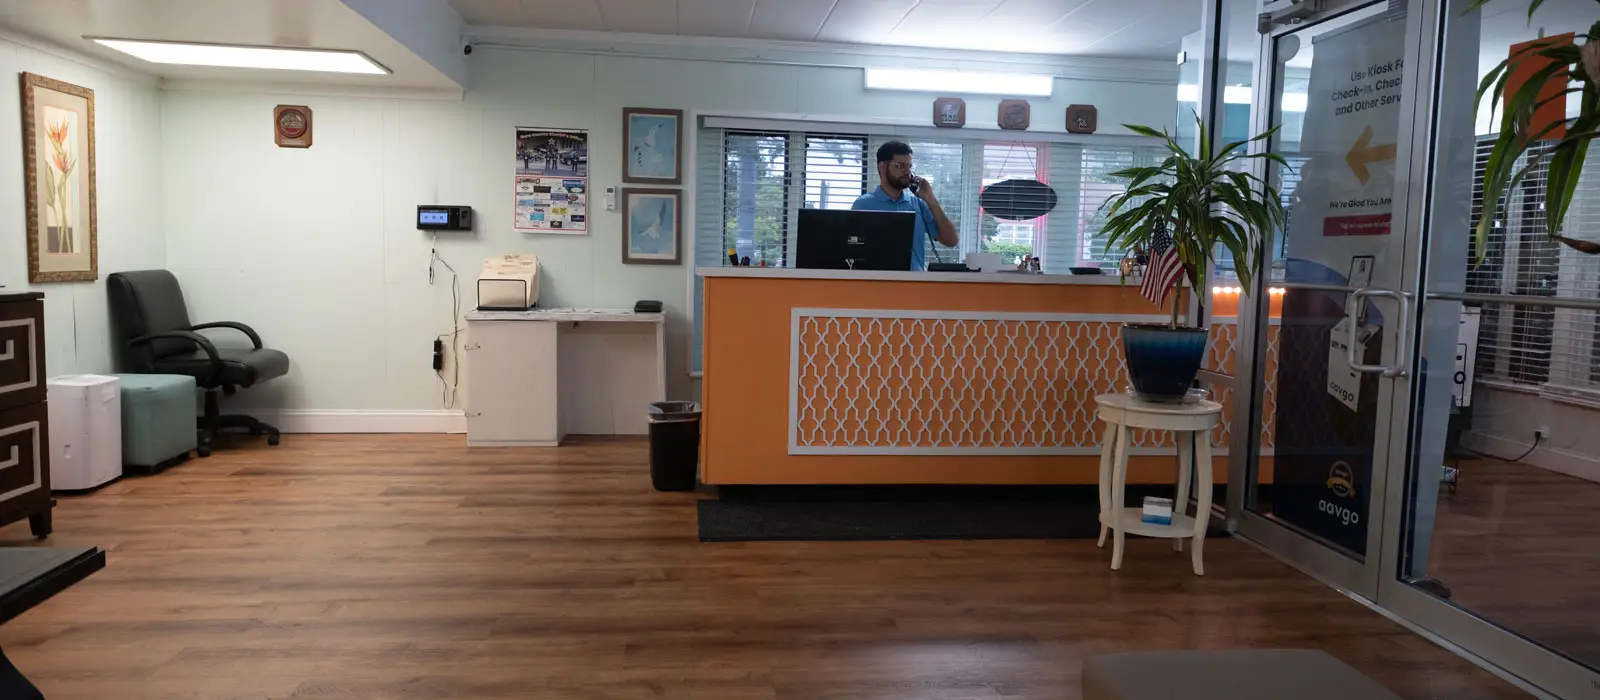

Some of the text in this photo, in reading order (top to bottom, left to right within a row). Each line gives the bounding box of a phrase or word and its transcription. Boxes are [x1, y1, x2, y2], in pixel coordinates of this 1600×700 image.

[1350, 71, 1366, 82] Use
[1368, 61, 1393, 76] Kiosk
[1335, 103, 1353, 116] and
[1354, 98, 1379, 112] Other
[1329, 200, 1348, 209] We're
[1348, 198, 1365, 208] Glad
[1366, 199, 1378, 207] You
[1319, 500, 1359, 525] aavgo
